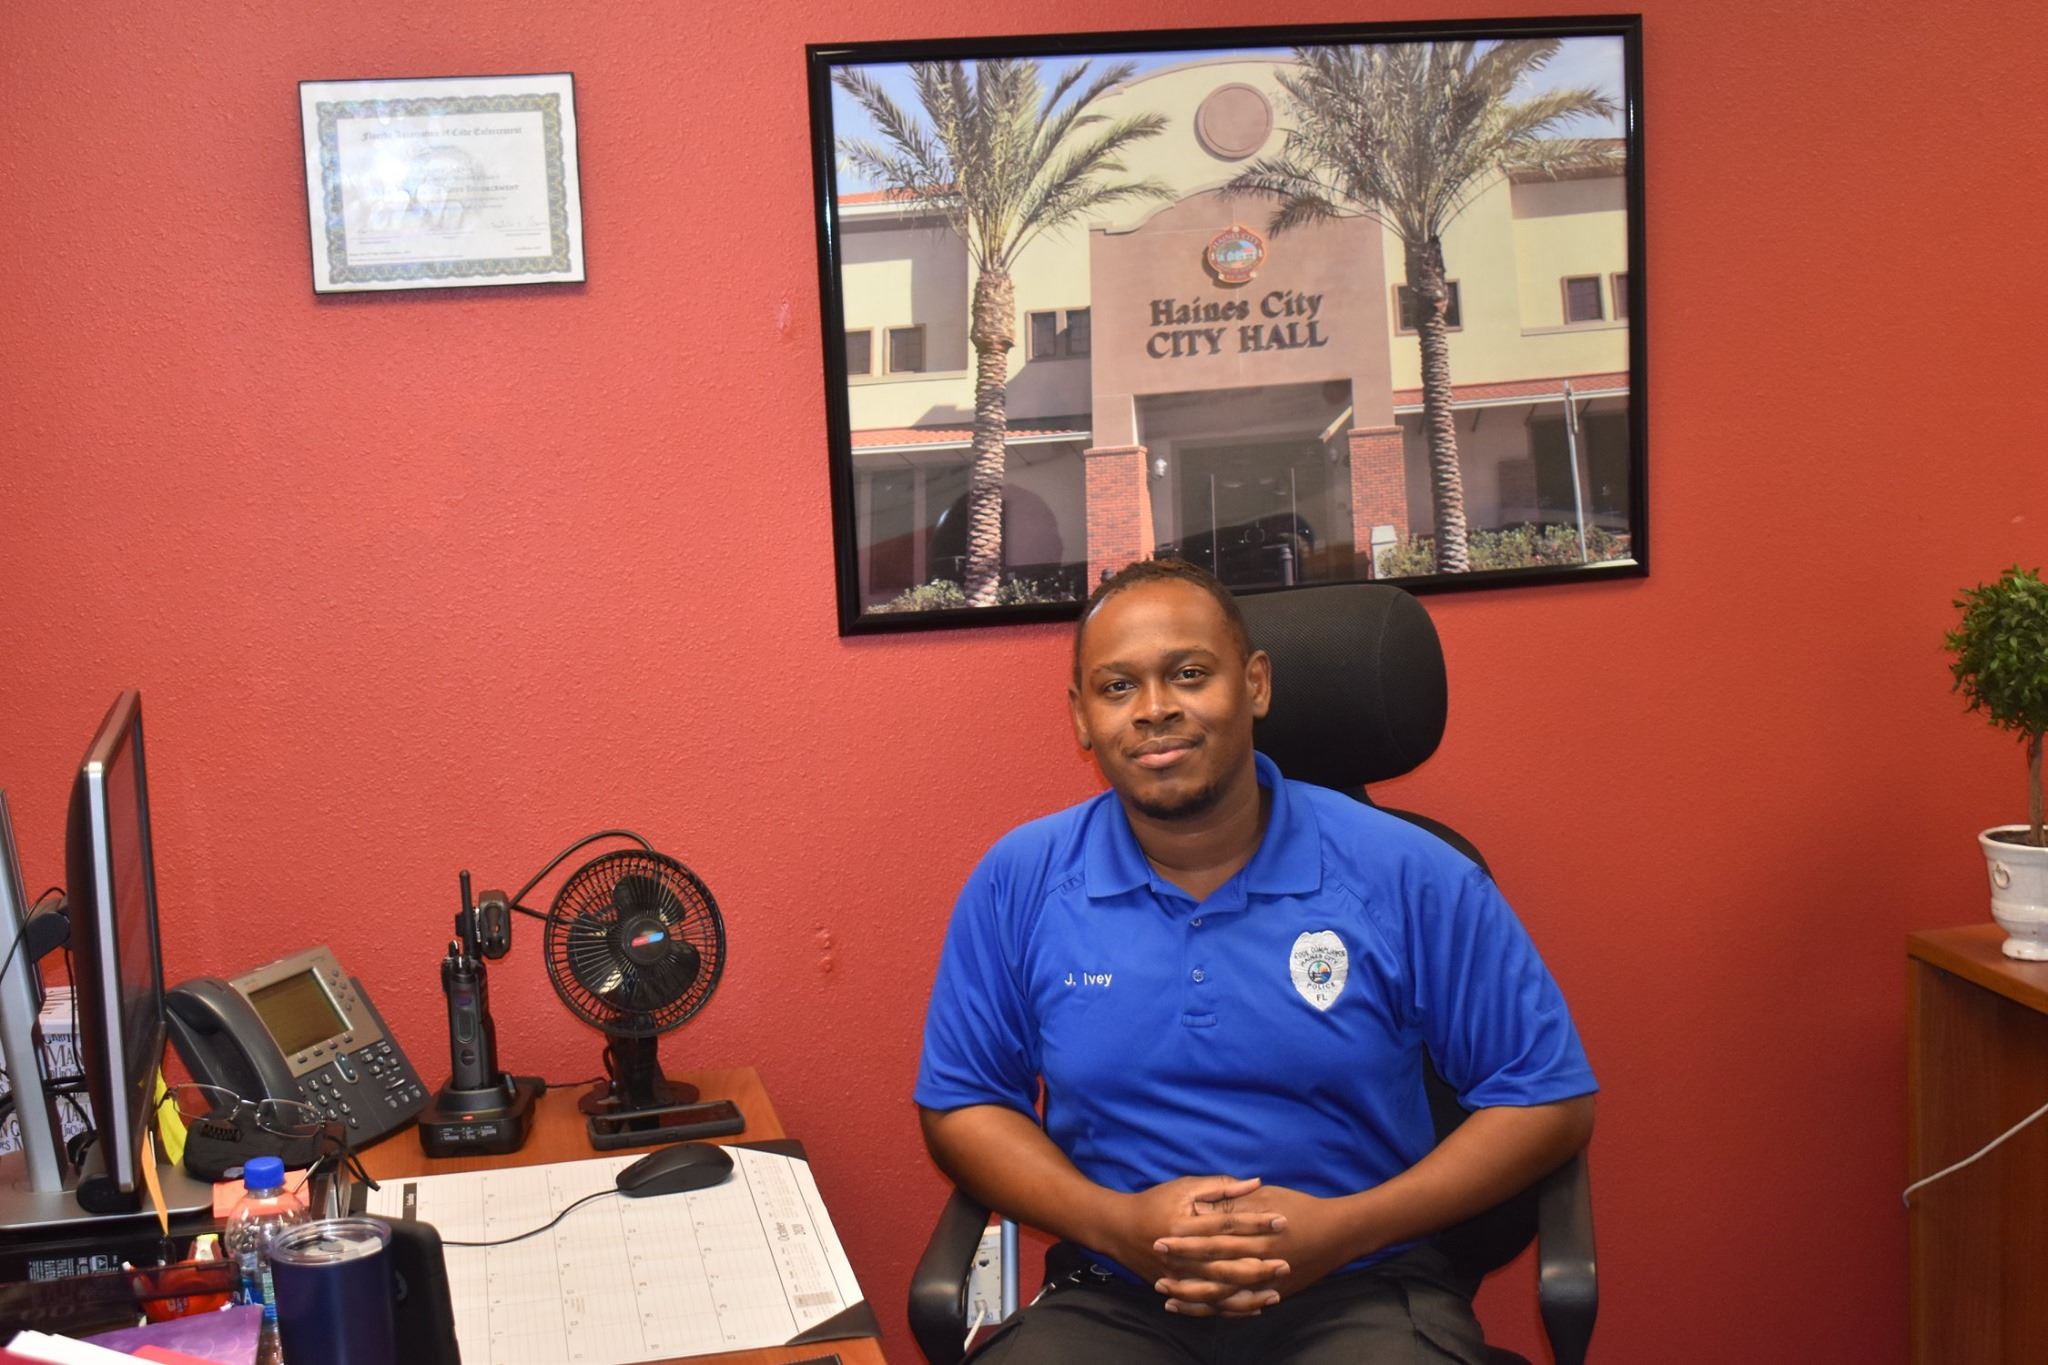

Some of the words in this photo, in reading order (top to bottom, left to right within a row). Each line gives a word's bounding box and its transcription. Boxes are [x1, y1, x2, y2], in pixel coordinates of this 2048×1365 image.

[1149, 296, 1250, 326] Haines
[1260, 289, 1324, 320] City
[1146, 327, 1227, 359] CITY
[1238, 321, 1329, 353] HALL
[1064, 972, 1077, 986] J.
[1083, 972, 1112, 988] Ivey
[1307, 982, 1335, 991] POLICE
[1316, 993, 1328, 1001] FL
